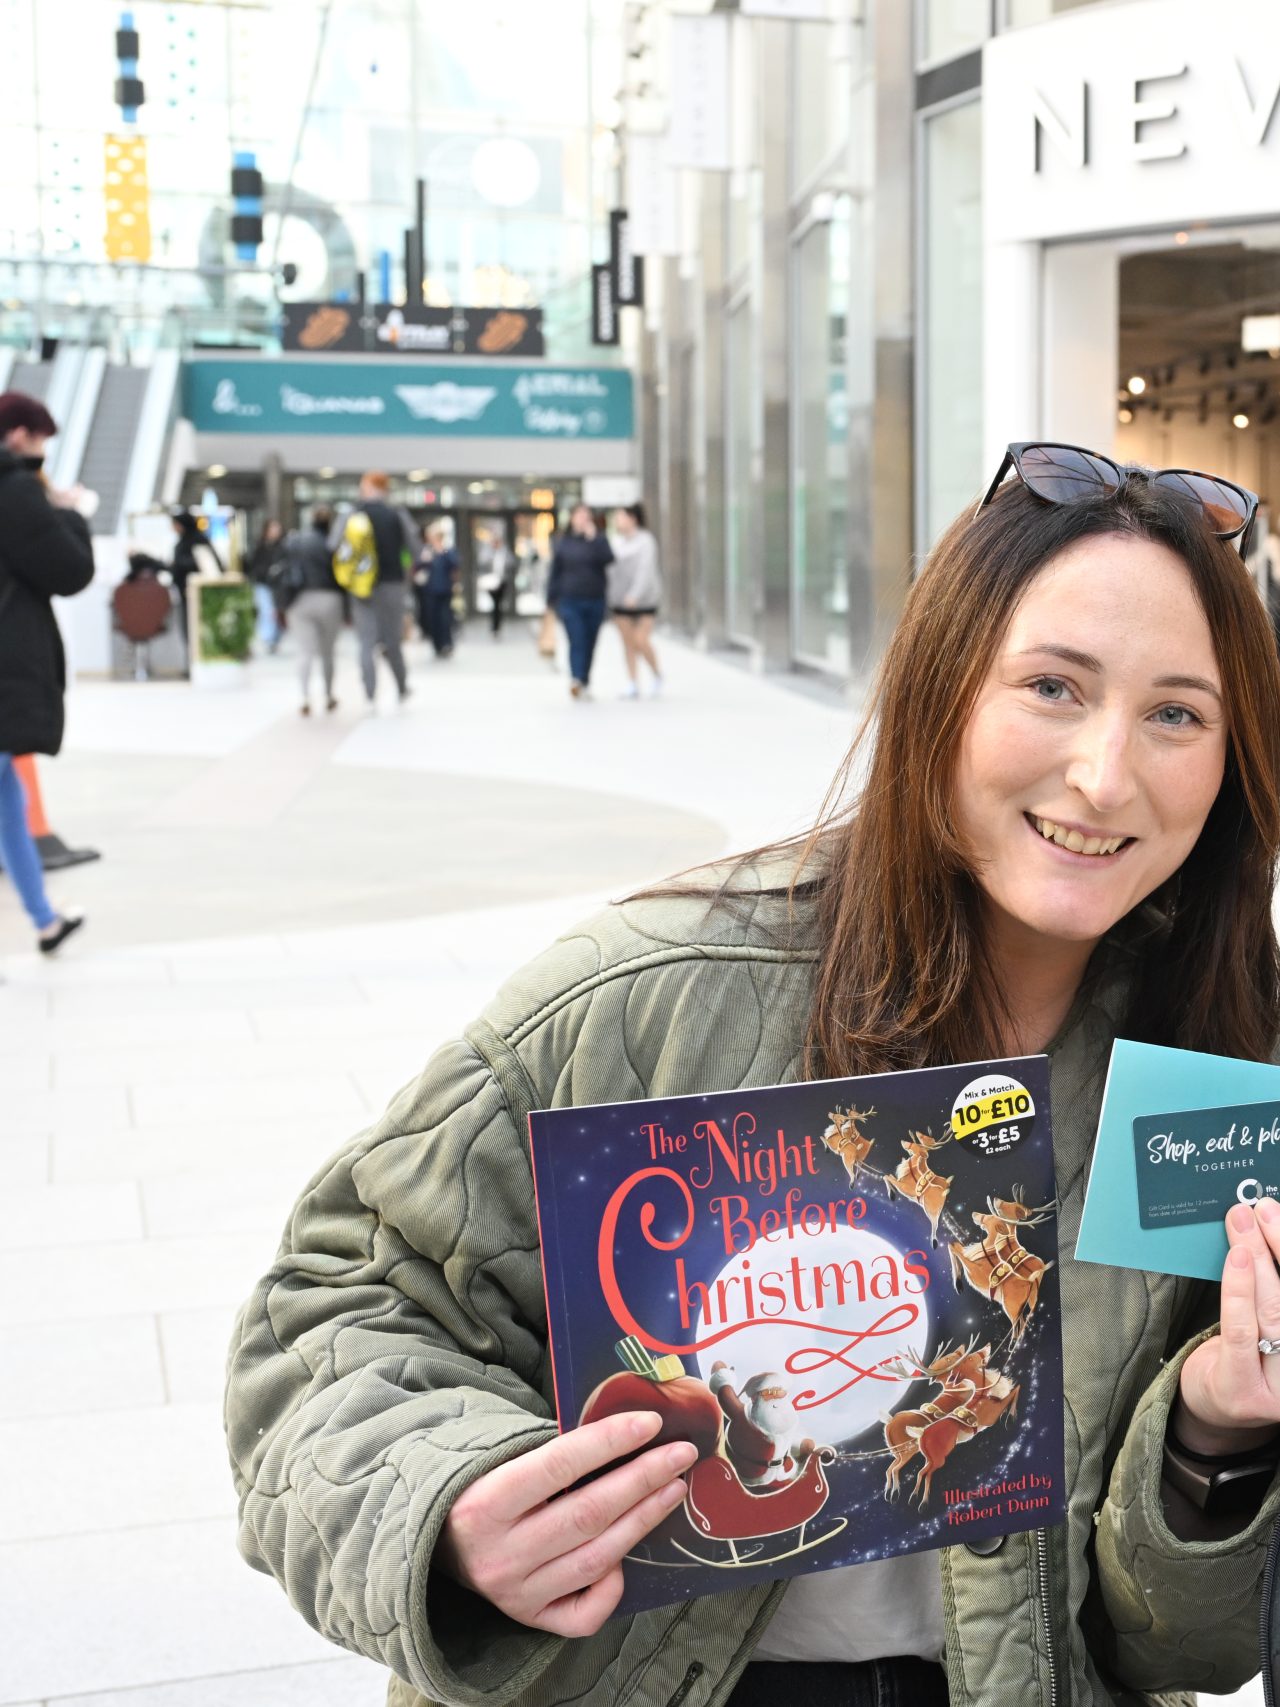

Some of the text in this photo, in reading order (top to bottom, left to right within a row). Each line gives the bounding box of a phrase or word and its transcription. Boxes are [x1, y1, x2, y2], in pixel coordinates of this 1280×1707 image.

[964, 1083, 1015, 1099] Mix & Match
[955, 1104, 981, 1126] 10
[991, 1094, 1030, 1119] £10
[977, 1132, 990, 1148] 3
[998, 1125, 1020, 1144] £5
[985, 1144, 1011, 1155] £2 each
[1146, 1131, 1200, 1164] Shop,
[1205, 1123, 1236, 1153] eat
[1239, 1125, 1254, 1146] &
[639, 1111, 821, 1196] The Night
[1194, 1158, 1255, 1173] TOGETHER
[1265, 1184, 1279, 1192] the
[709, 1188, 869, 1256] Before
[597, 1166, 932, 1354] Christmas
[944, 1473, 1052, 1505] Illustrated by
[948, 1495, 1049, 1525] Robert Dunn
